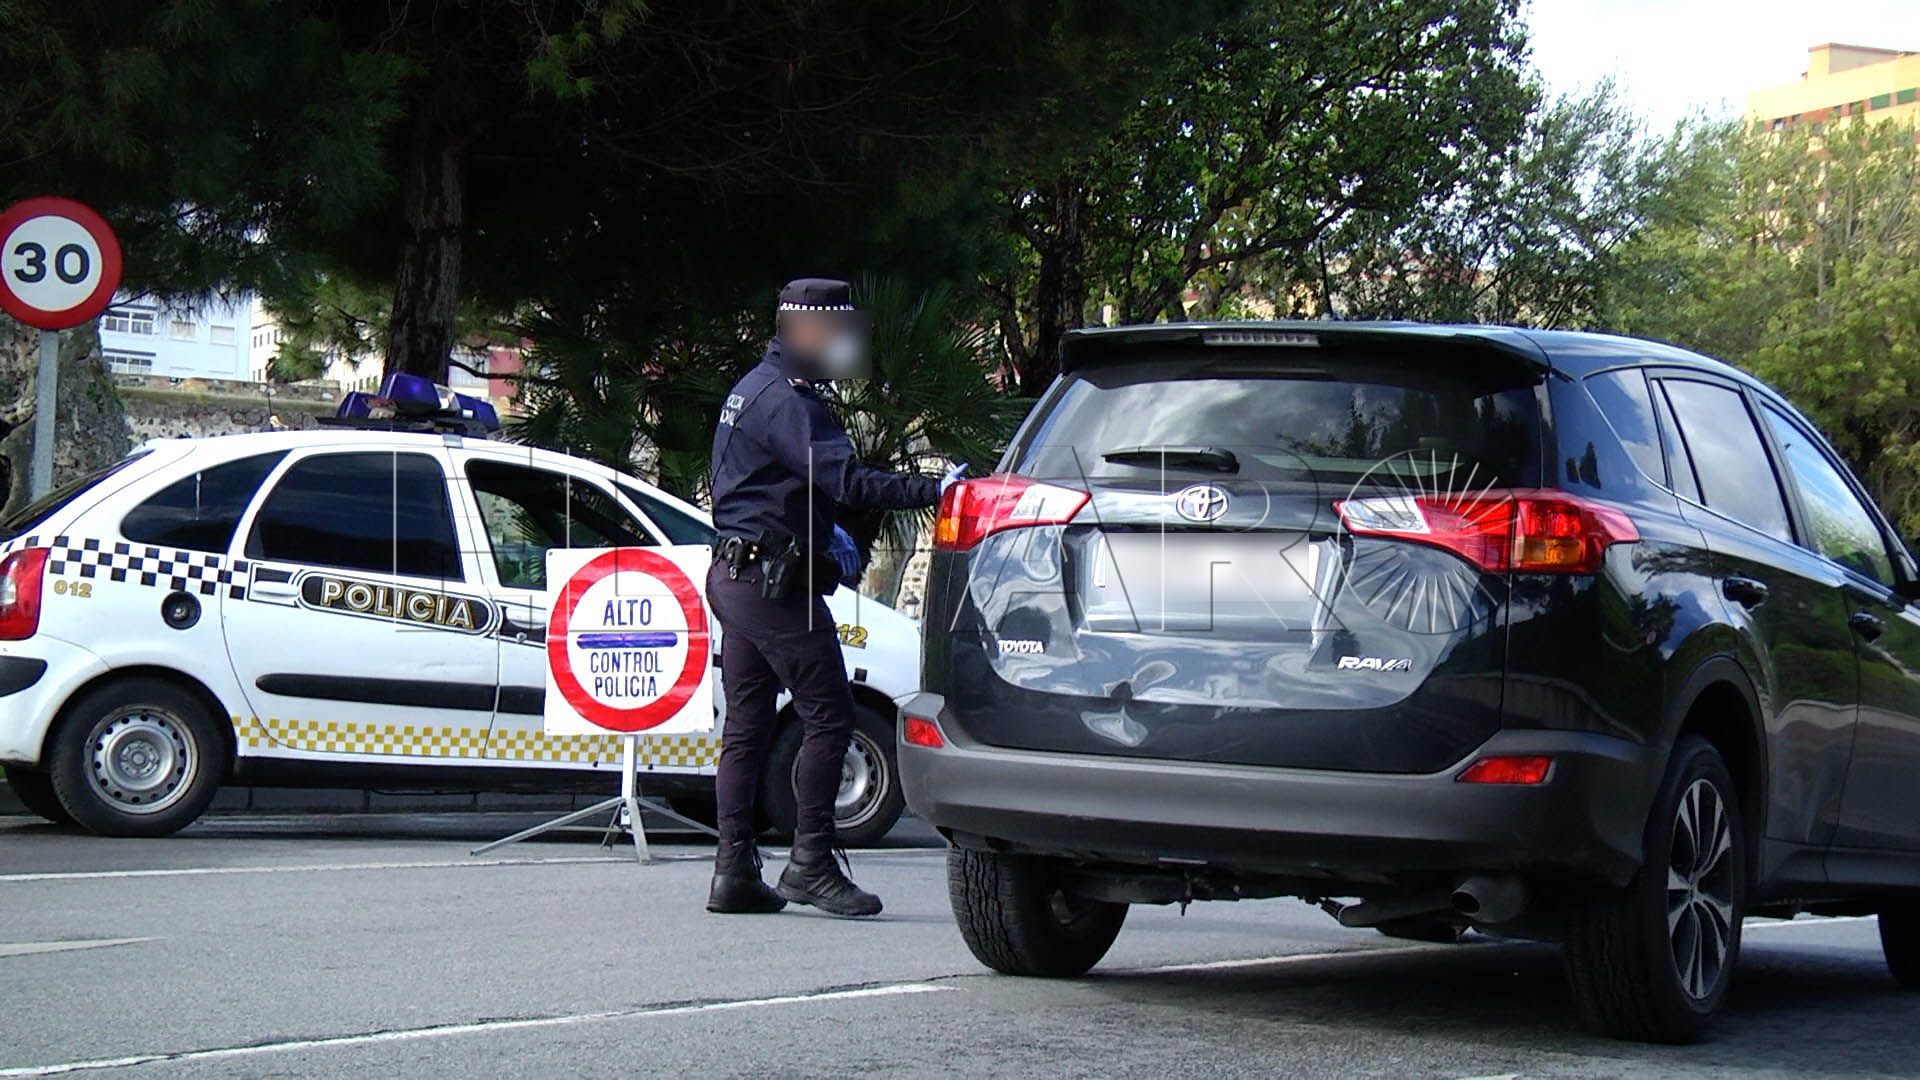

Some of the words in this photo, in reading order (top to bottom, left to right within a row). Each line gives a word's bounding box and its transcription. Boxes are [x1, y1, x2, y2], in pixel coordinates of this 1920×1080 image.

[14, 242, 90, 285] 30
[54, 579, 93, 598] 012
[320, 578, 475, 629] POLICIA
[603, 599, 652, 626] ALTO
[836, 623, 868, 650] 12
[997, 639, 1044, 654] TOYOTA
[590, 651, 664, 674] CONTROL
[1337, 655, 1414, 672] RAV4
[595, 675, 658, 698] POLICIA
